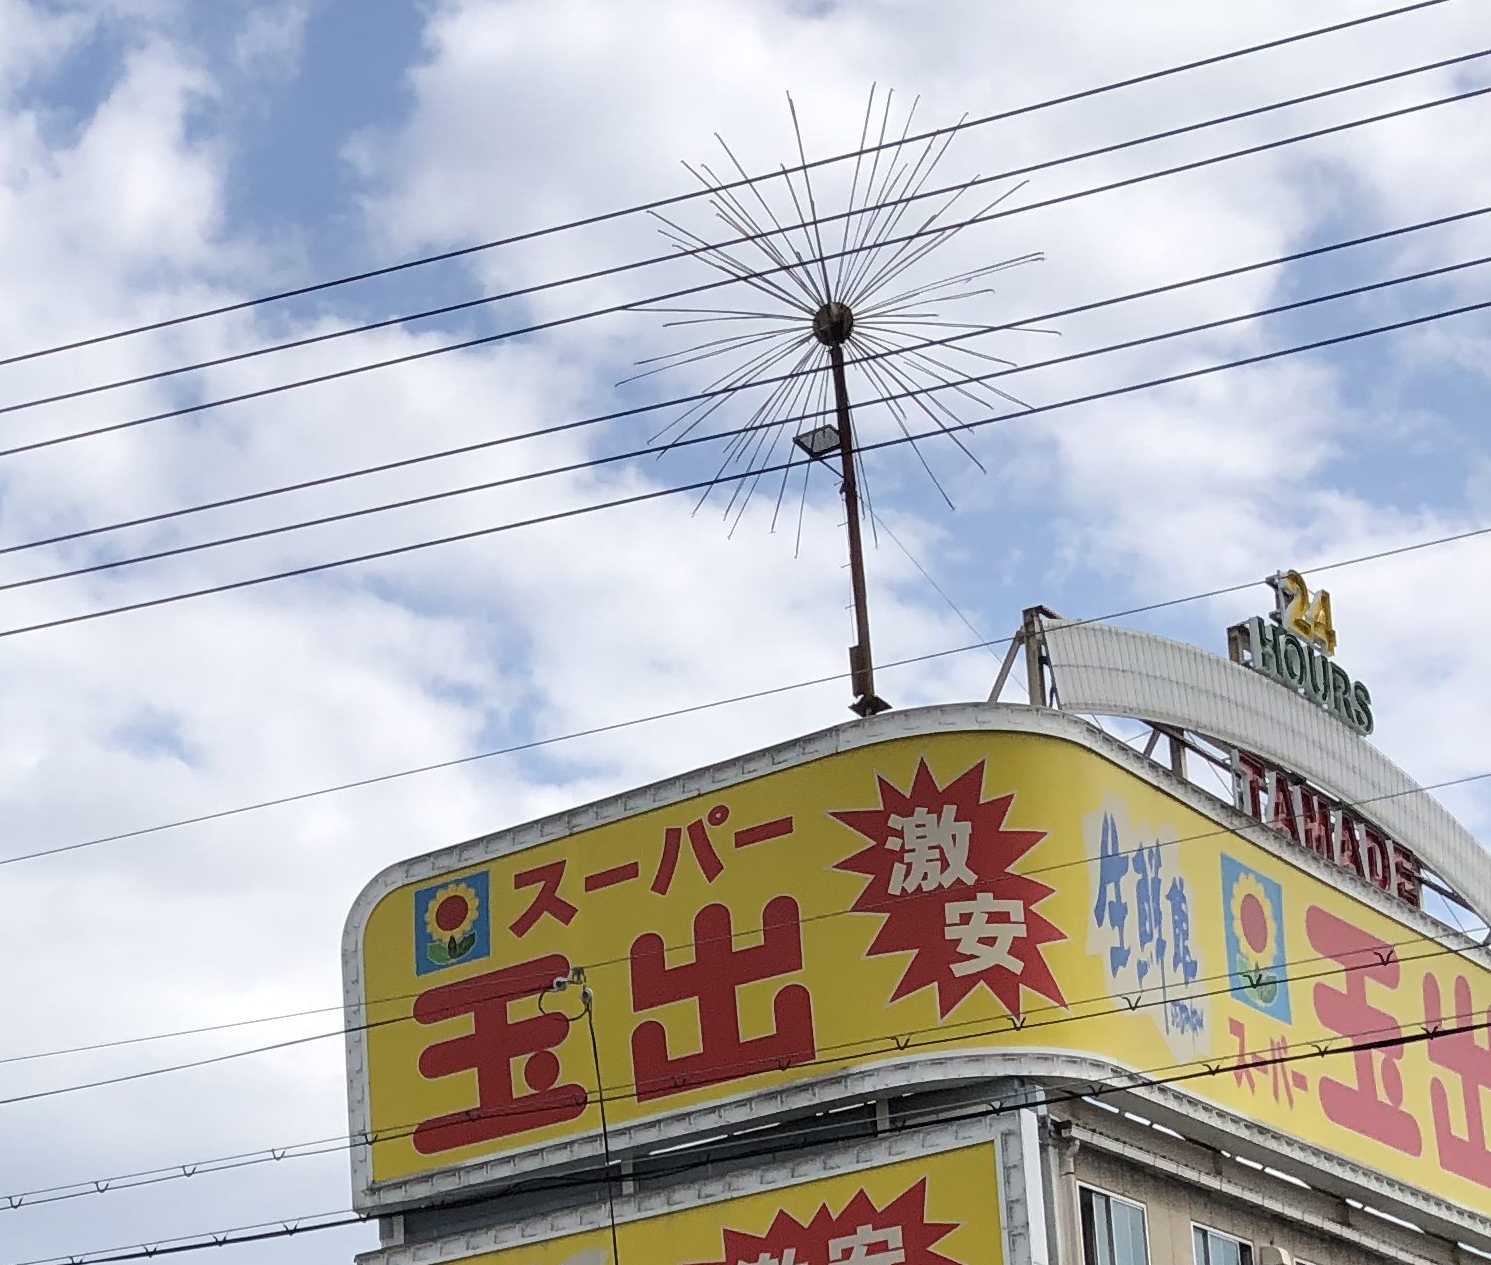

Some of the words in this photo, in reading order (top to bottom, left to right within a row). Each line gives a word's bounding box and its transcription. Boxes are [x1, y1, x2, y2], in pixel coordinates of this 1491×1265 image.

[1253, 615, 1374, 737] HOURS
[1280, 569, 1337, 656] 24
[508, 804, 796, 939] スーパー
[882, 804, 1028, 978] 激安
[1233, 748, 1422, 909] TAMADE
[412, 895, 816, 1155] 玉出
[1228, 1016, 1308, 1111] スーパー
